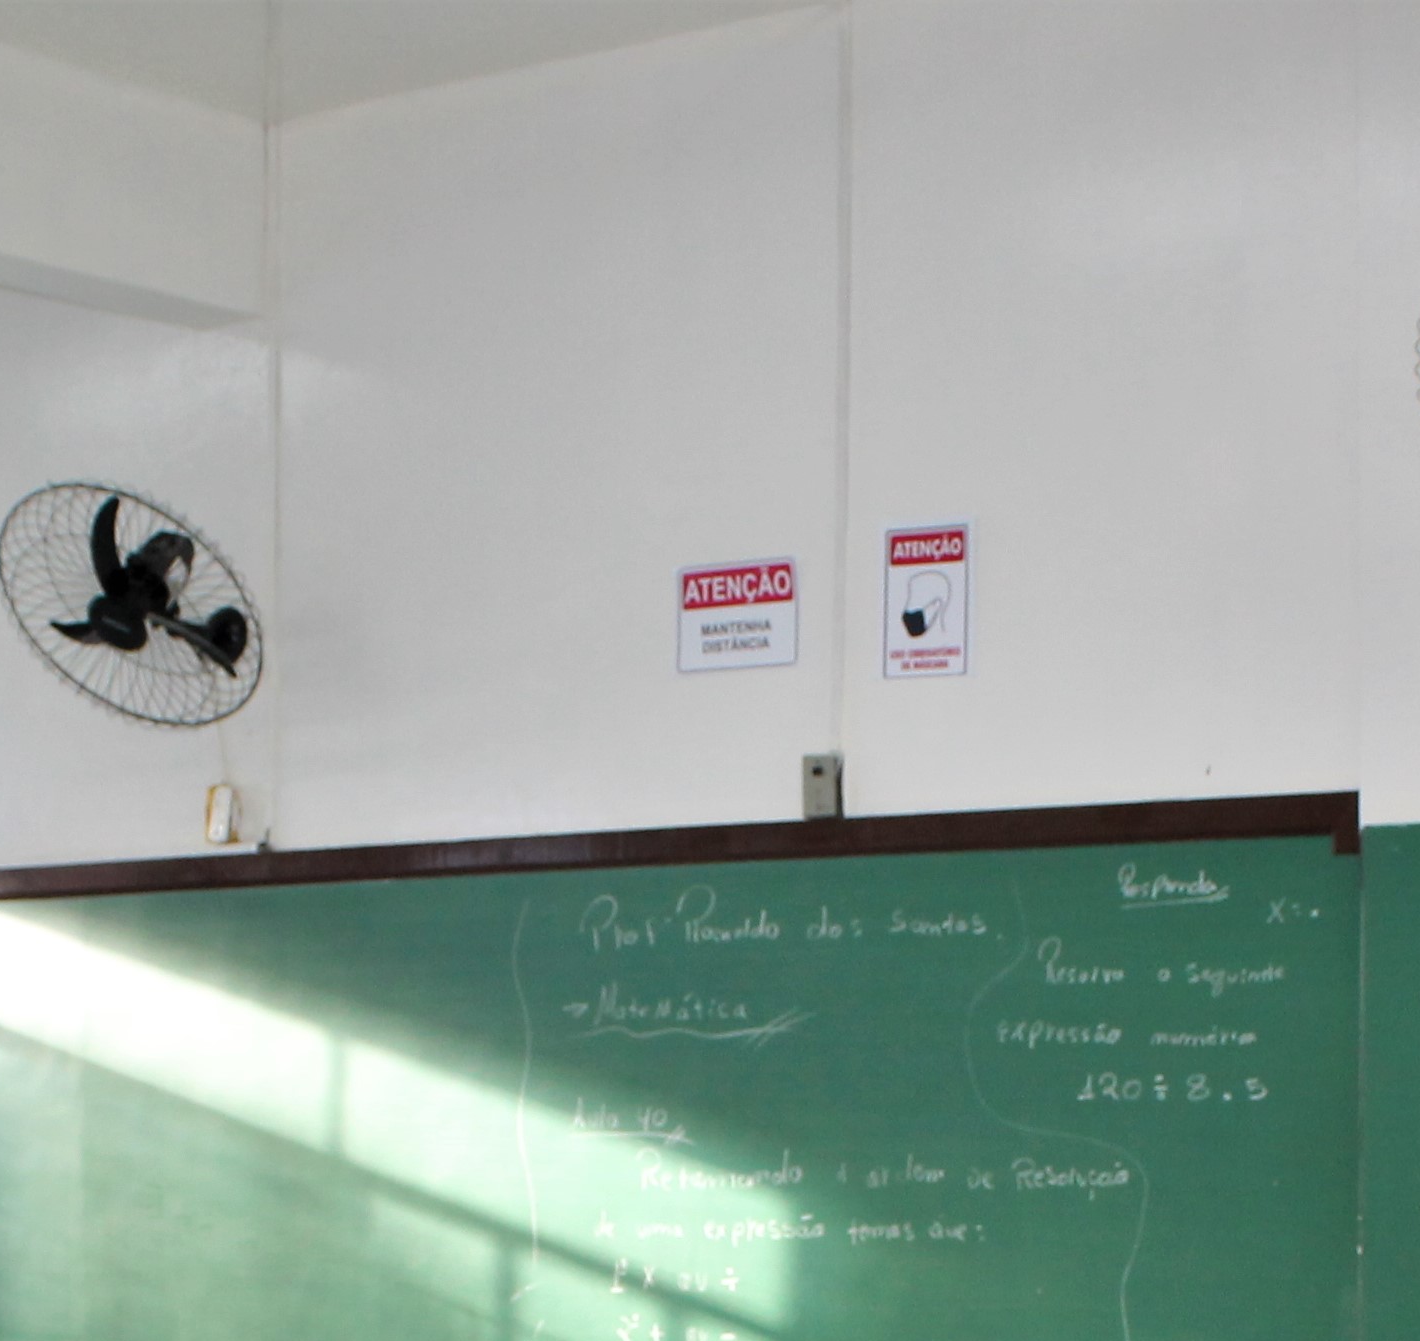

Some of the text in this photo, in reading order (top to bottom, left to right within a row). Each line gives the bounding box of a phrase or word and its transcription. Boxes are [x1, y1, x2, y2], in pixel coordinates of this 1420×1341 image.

[891, 536, 964, 560] ATENÇÃO
[683, 567, 792, 603] ATENÇÃO
[700, 619, 771, 636] MANTENHA
